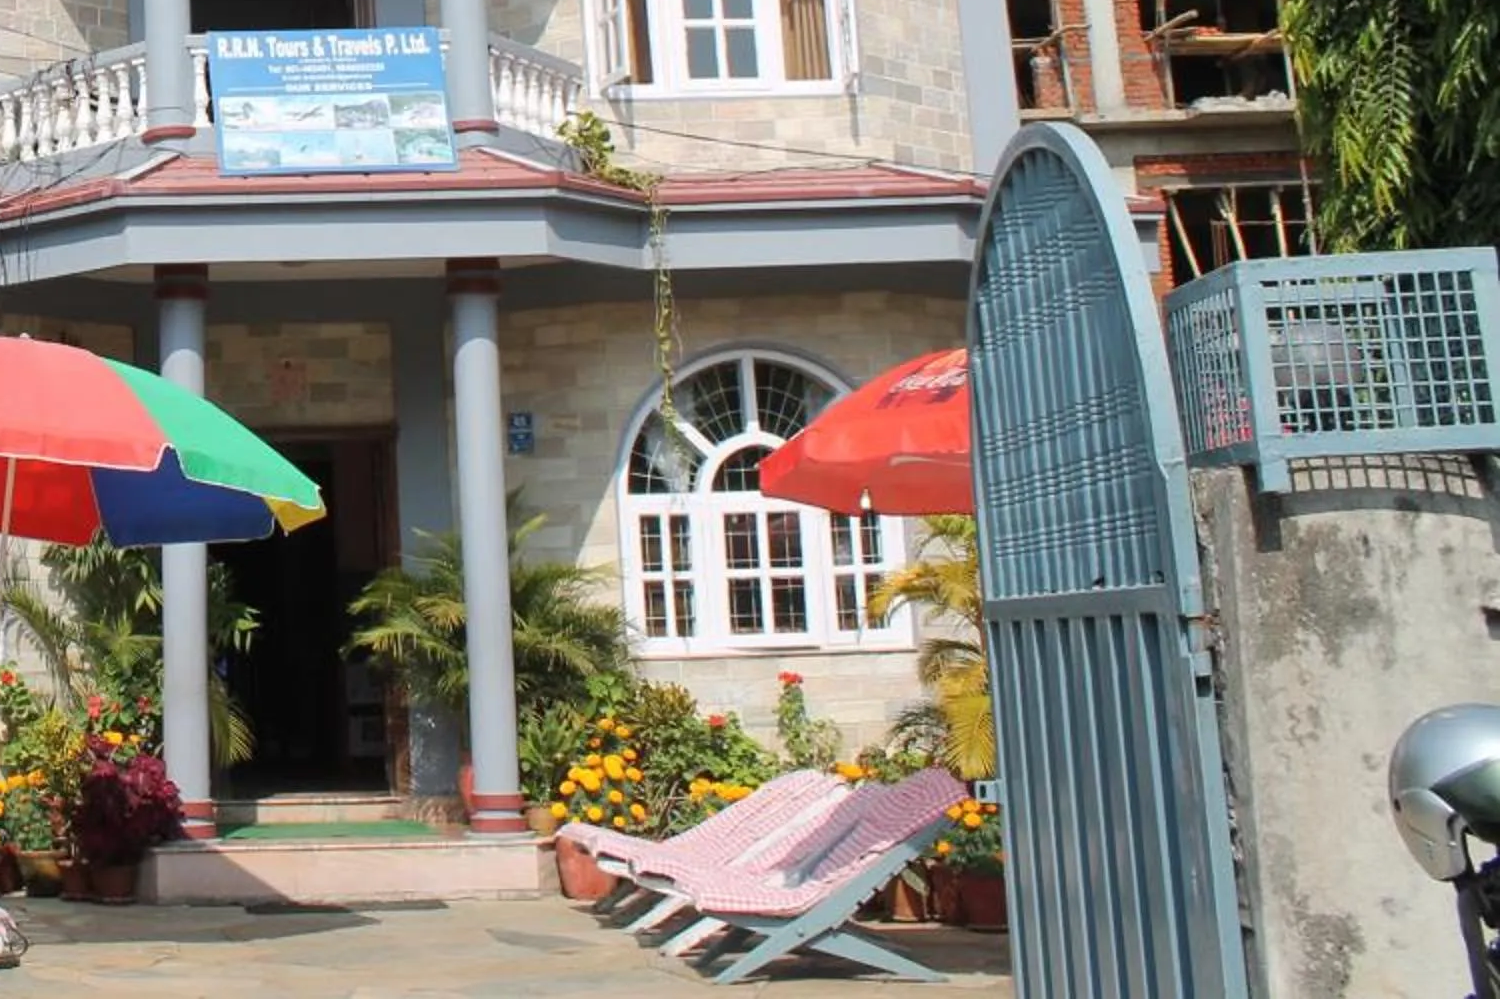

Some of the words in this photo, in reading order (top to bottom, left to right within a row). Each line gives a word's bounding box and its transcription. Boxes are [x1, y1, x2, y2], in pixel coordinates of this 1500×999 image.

[265, 36, 309, 58] Tours
[313, 35, 326, 58] &
[327, 33, 383, 57] Travels
[385, 33, 399, 56] P.
[400, 32, 431, 55] Ltd.
